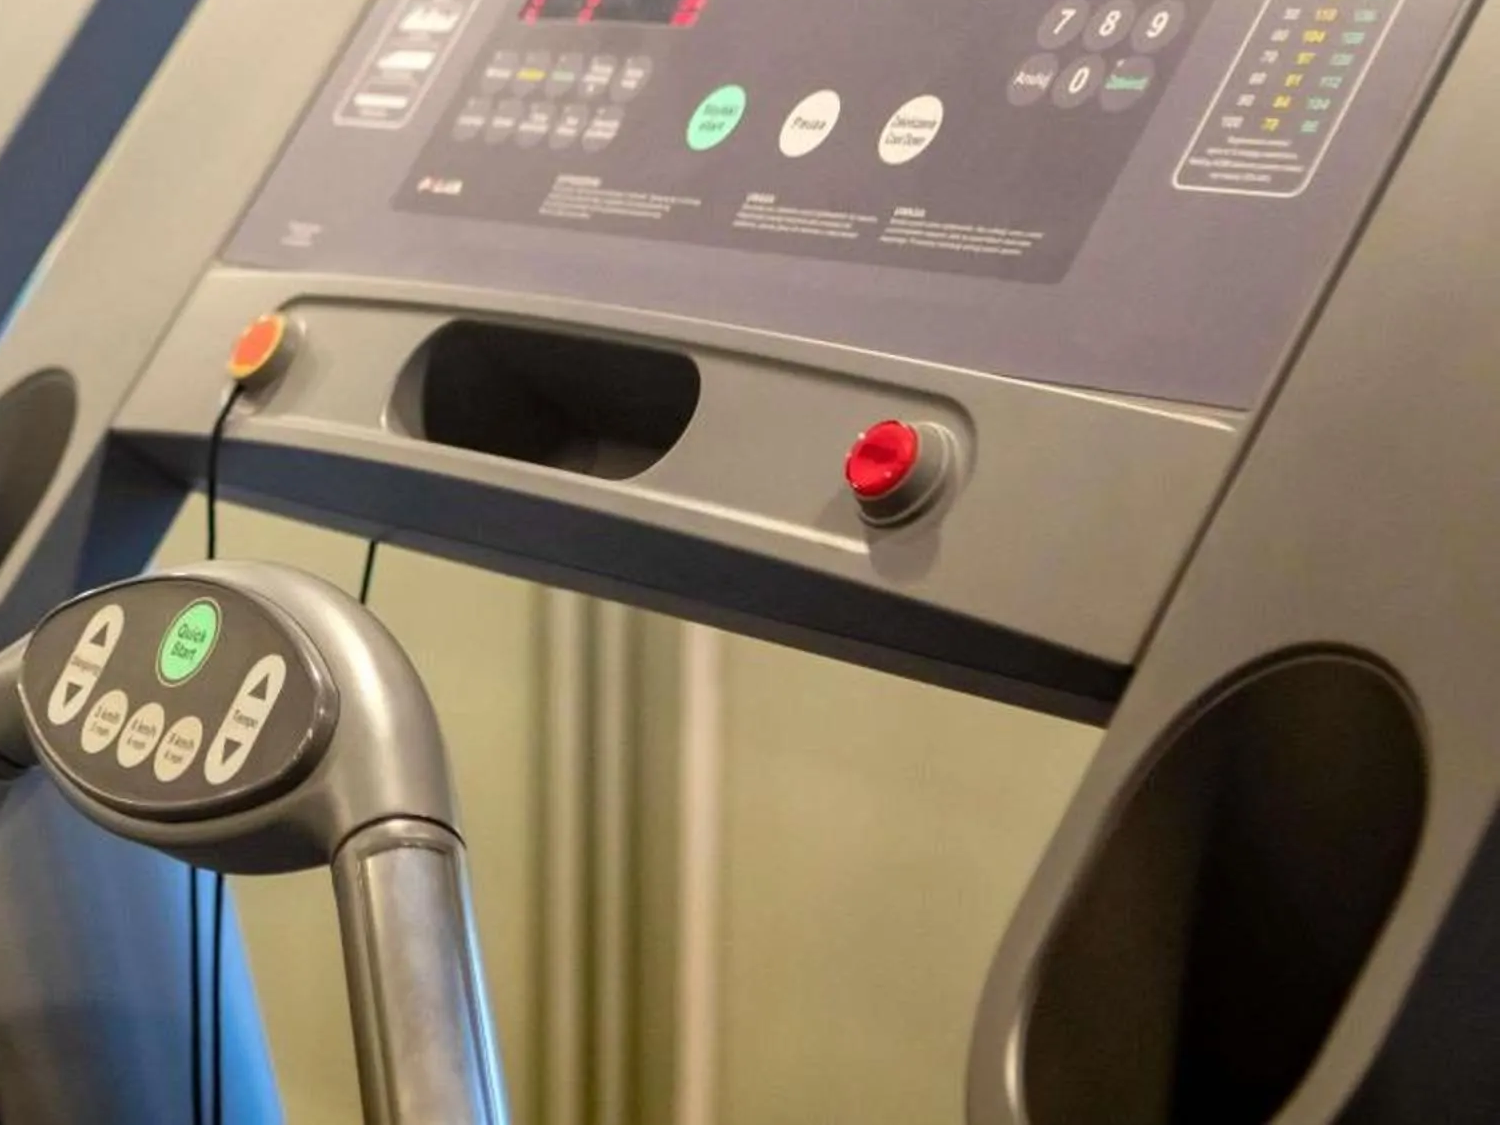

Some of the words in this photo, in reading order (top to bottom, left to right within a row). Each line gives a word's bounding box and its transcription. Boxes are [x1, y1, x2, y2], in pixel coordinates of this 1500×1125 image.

[1053, 8, 1078, 36] 7
[1098, 9, 1123, 37] 8
[1145, 11, 1170, 38] 9
[1067, 66, 1091, 94] 0
[176, 623, 208, 644] Quick
